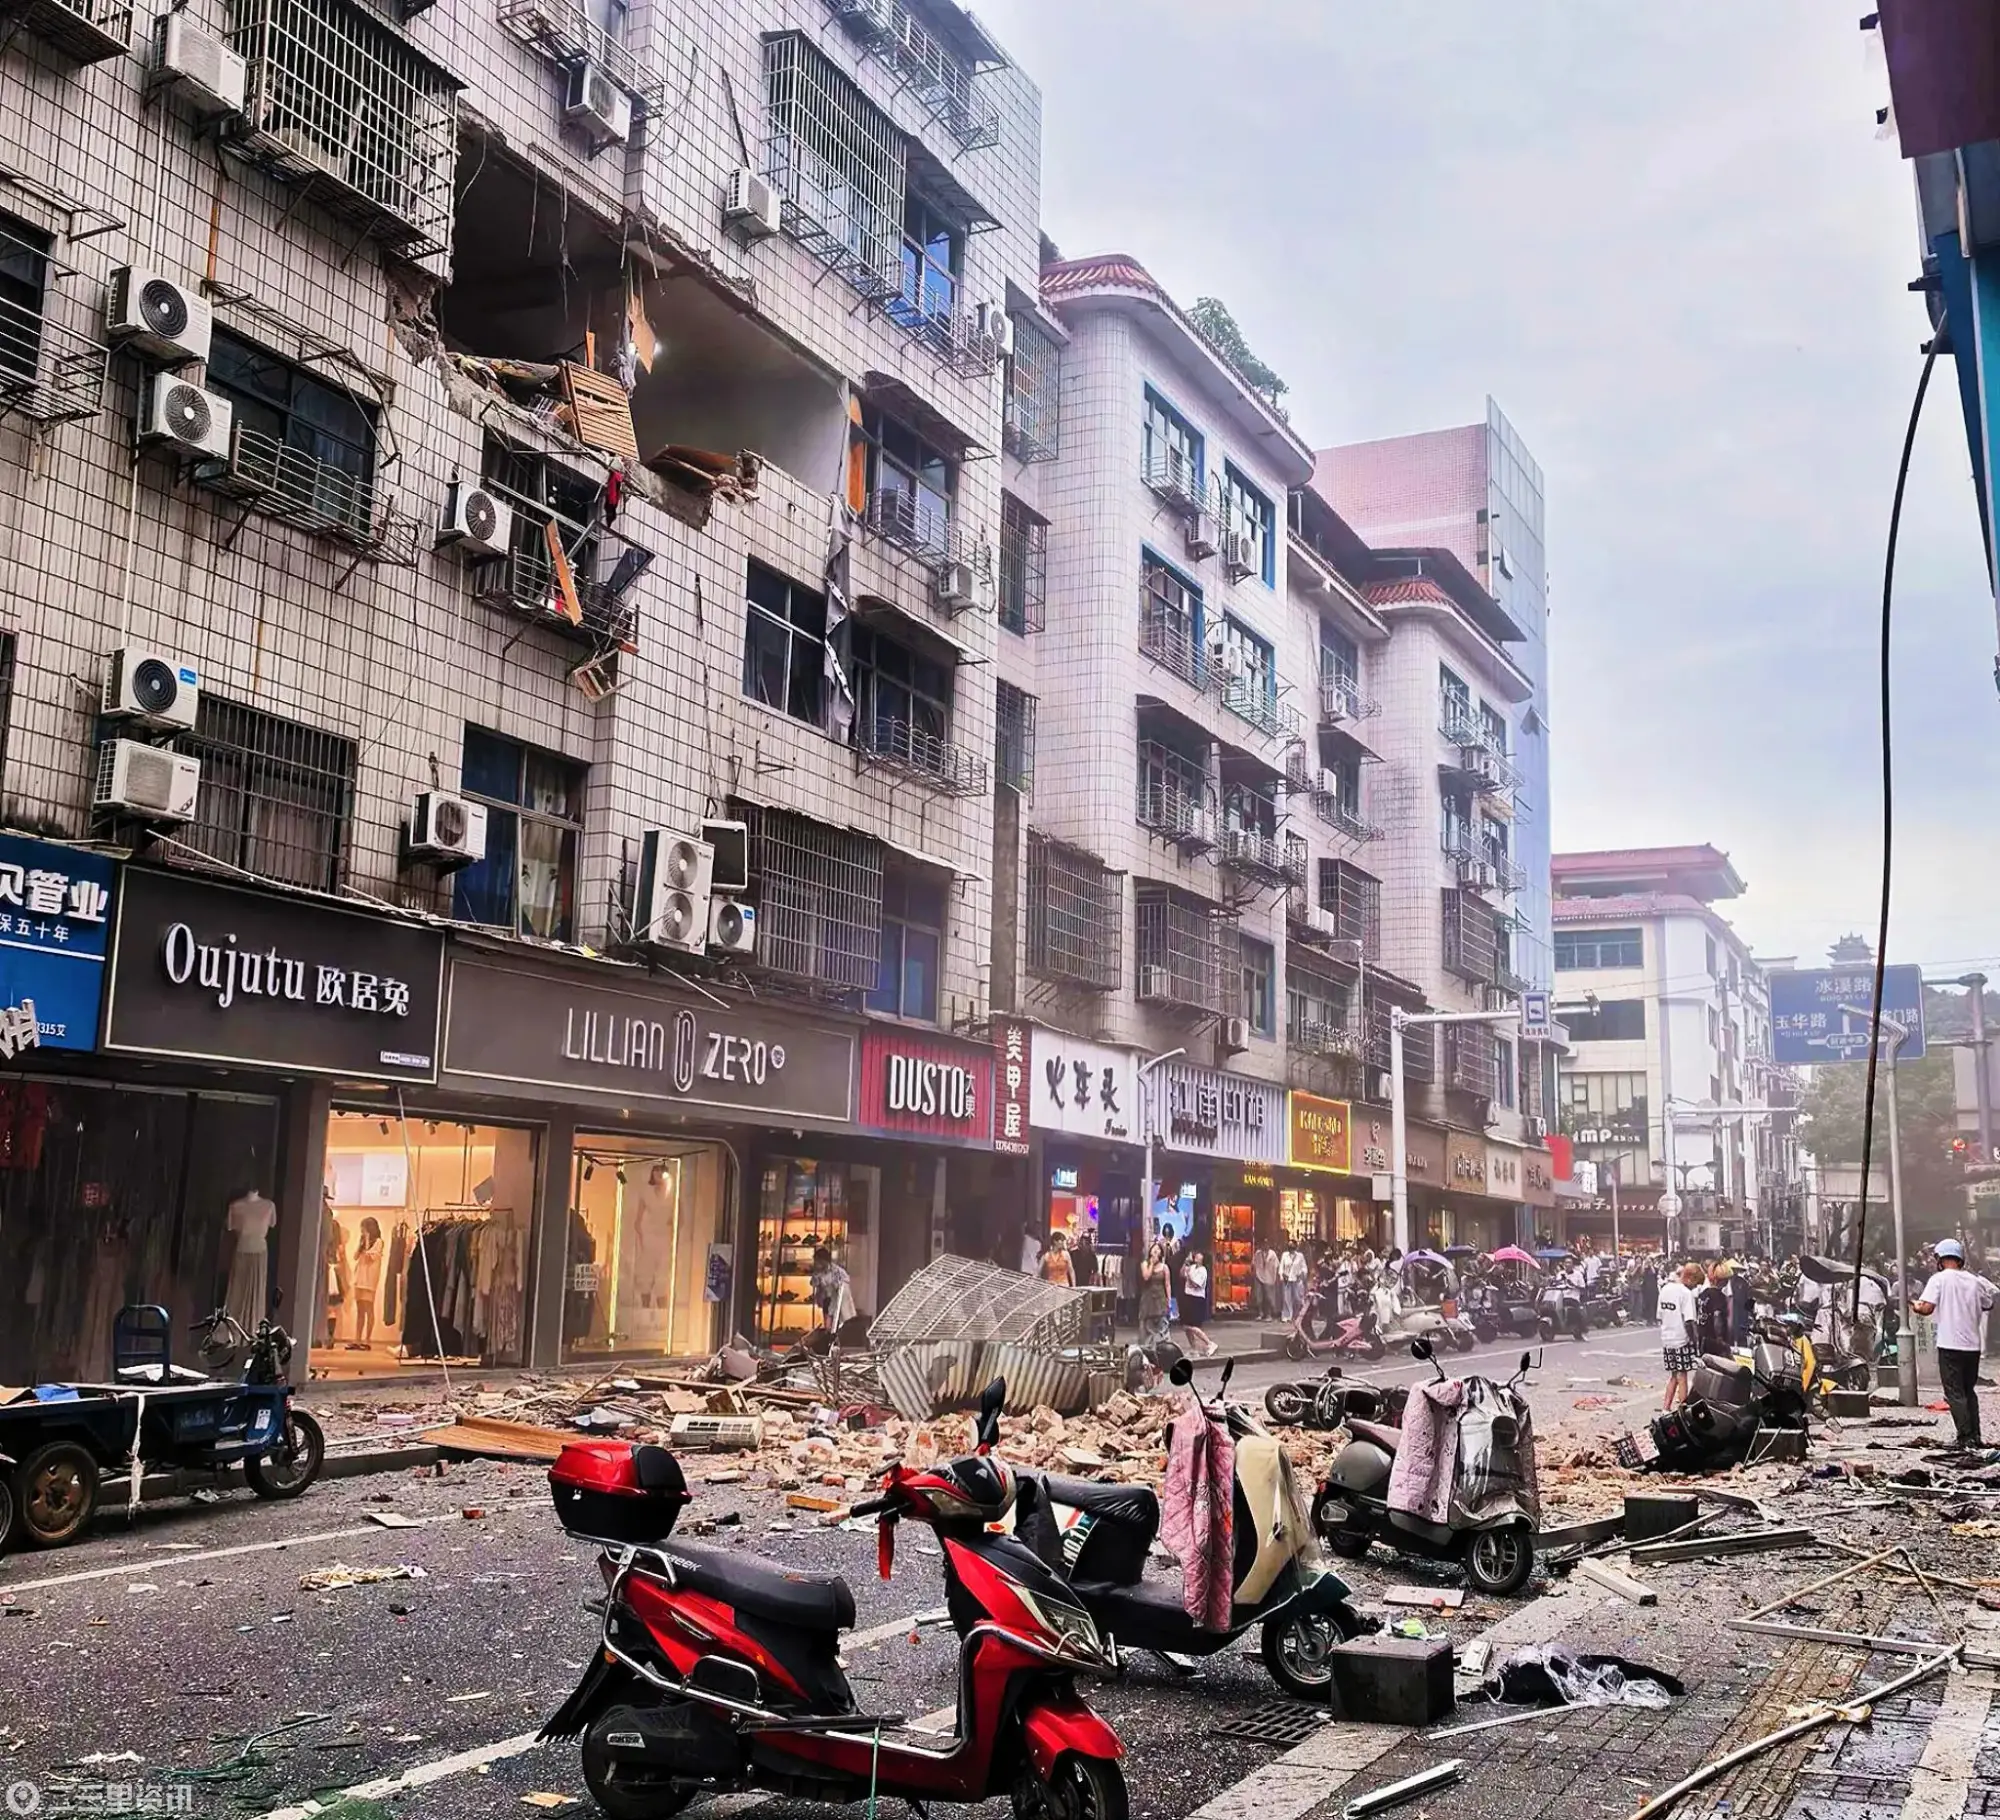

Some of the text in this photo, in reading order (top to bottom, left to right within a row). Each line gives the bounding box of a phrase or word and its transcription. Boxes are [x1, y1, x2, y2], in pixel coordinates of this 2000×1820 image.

[163, 922, 305, 1008] Oujutu
[566, 1008, 664, 1070] LILLIAN
[702, 1032, 767, 1086] ZERO
[1775, 1012, 1828, 1030] 玉华路
[889, 1055, 965, 1118] DUSTO
